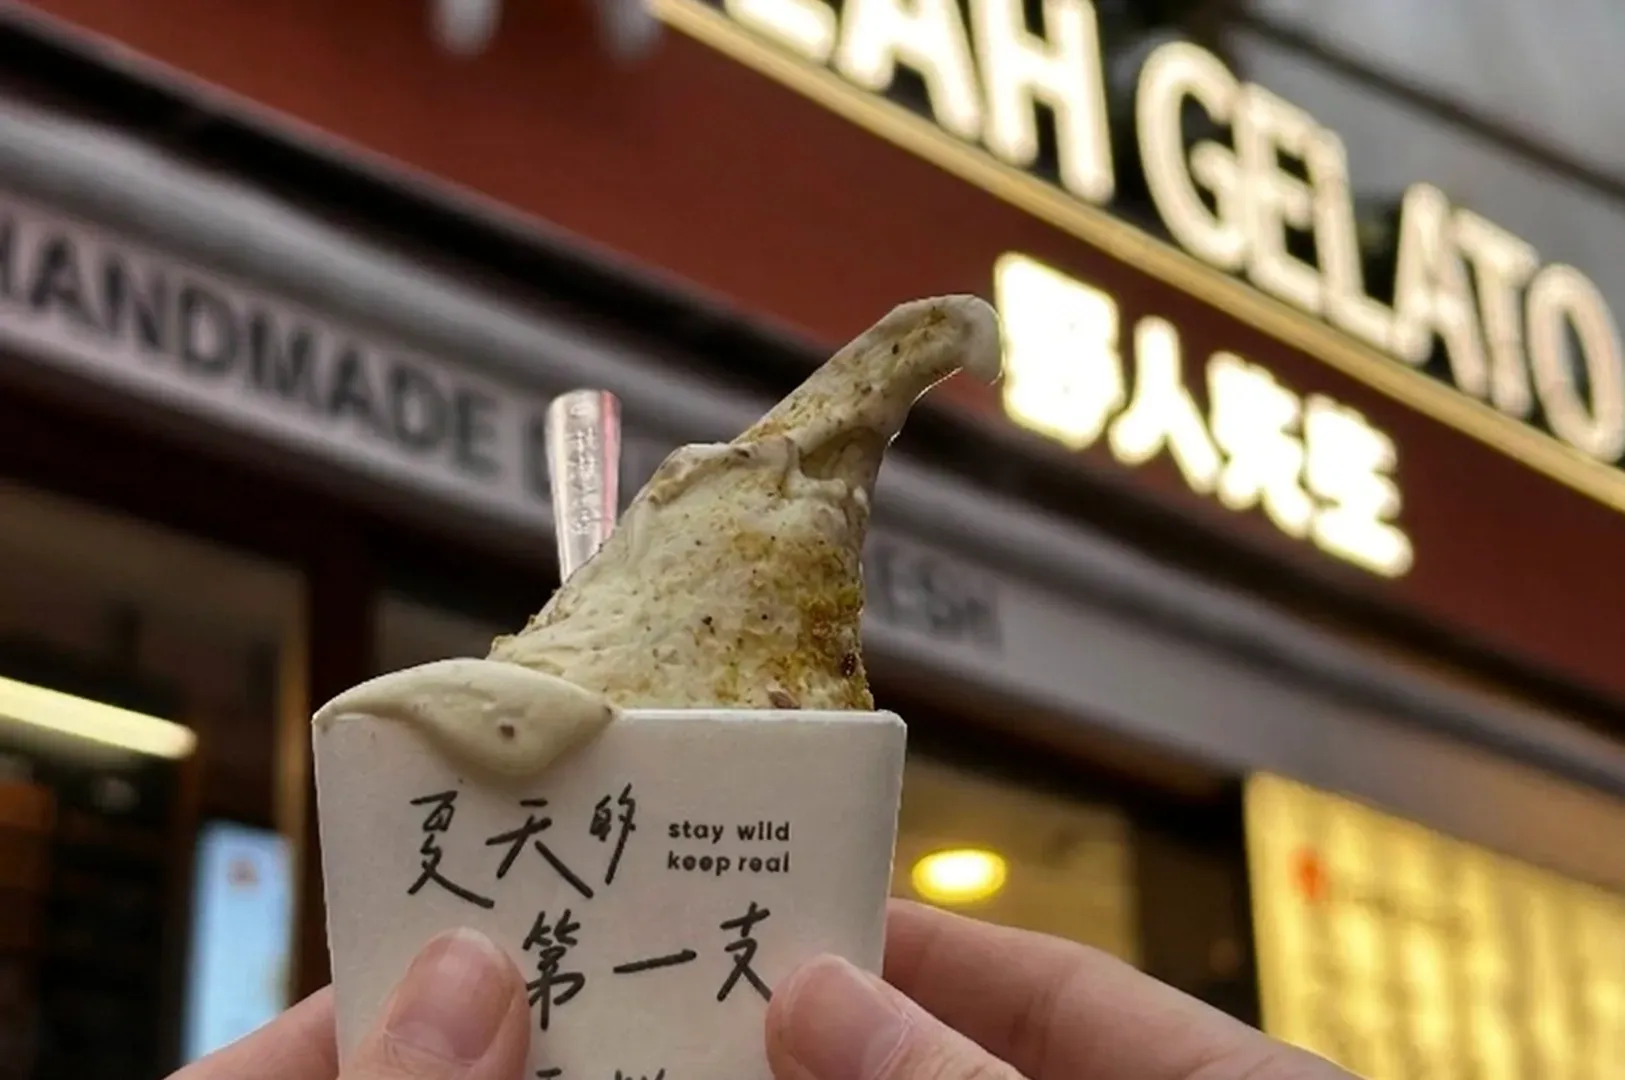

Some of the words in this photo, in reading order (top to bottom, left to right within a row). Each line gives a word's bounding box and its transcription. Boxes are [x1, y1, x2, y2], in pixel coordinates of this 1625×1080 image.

[724, 0, 1115, 205] AH
[1136, 41, 1624, 463] GELATO
[408, 783, 637, 911] 夏天的
[667, 850, 731, 877] keep
[738, 851, 790, 873] real
[668, 820, 724, 845] stay
[737, 820, 790, 842] wild
[524, 902, 772, 1032] 第一支
